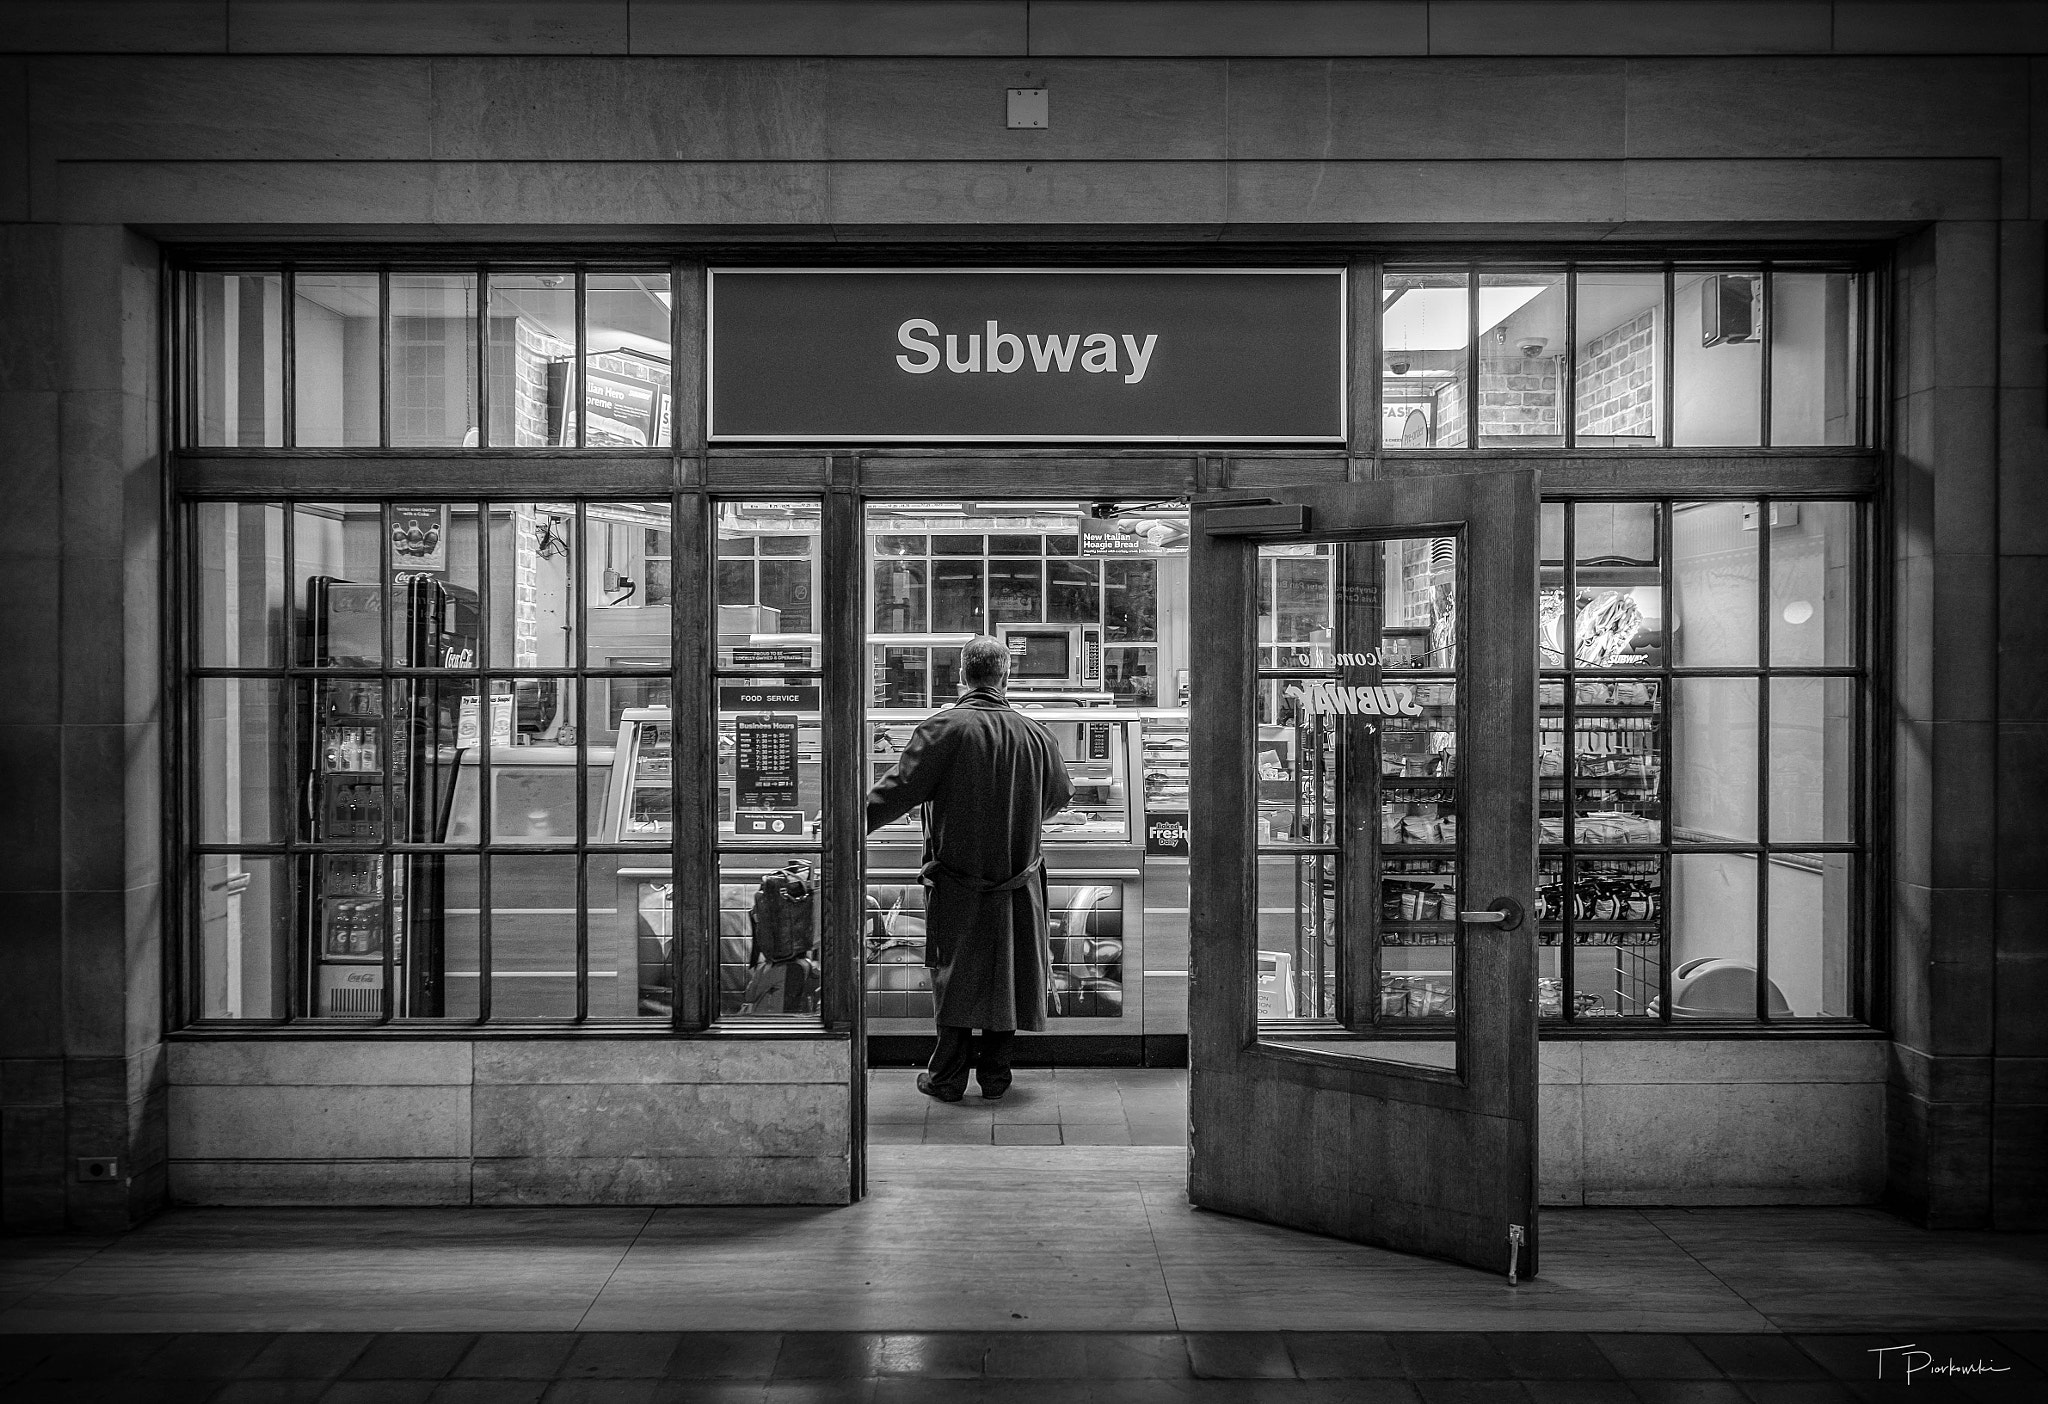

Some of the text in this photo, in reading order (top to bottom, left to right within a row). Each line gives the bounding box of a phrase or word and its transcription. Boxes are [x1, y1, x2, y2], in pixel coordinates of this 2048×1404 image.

[896, 317, 1158, 384] Subway
[587, 382, 603, 395] lian
[605, 386, 624, 400] Hero
[586, 396, 612, 409] preme
[1383, 407, 1413, 417] FAST
[1084, 533, 1131, 541] New Italian
[1084, 540, 1139, 549] Hoagie Bread
[1608, 653, 1649, 664] SUBWAY
[739, 722, 795, 730] Business Hours
[1156, 821, 1180, 829] Baked
[1149, 826, 1188, 839] Fresh
[1158, 838, 1179, 847] Daily
